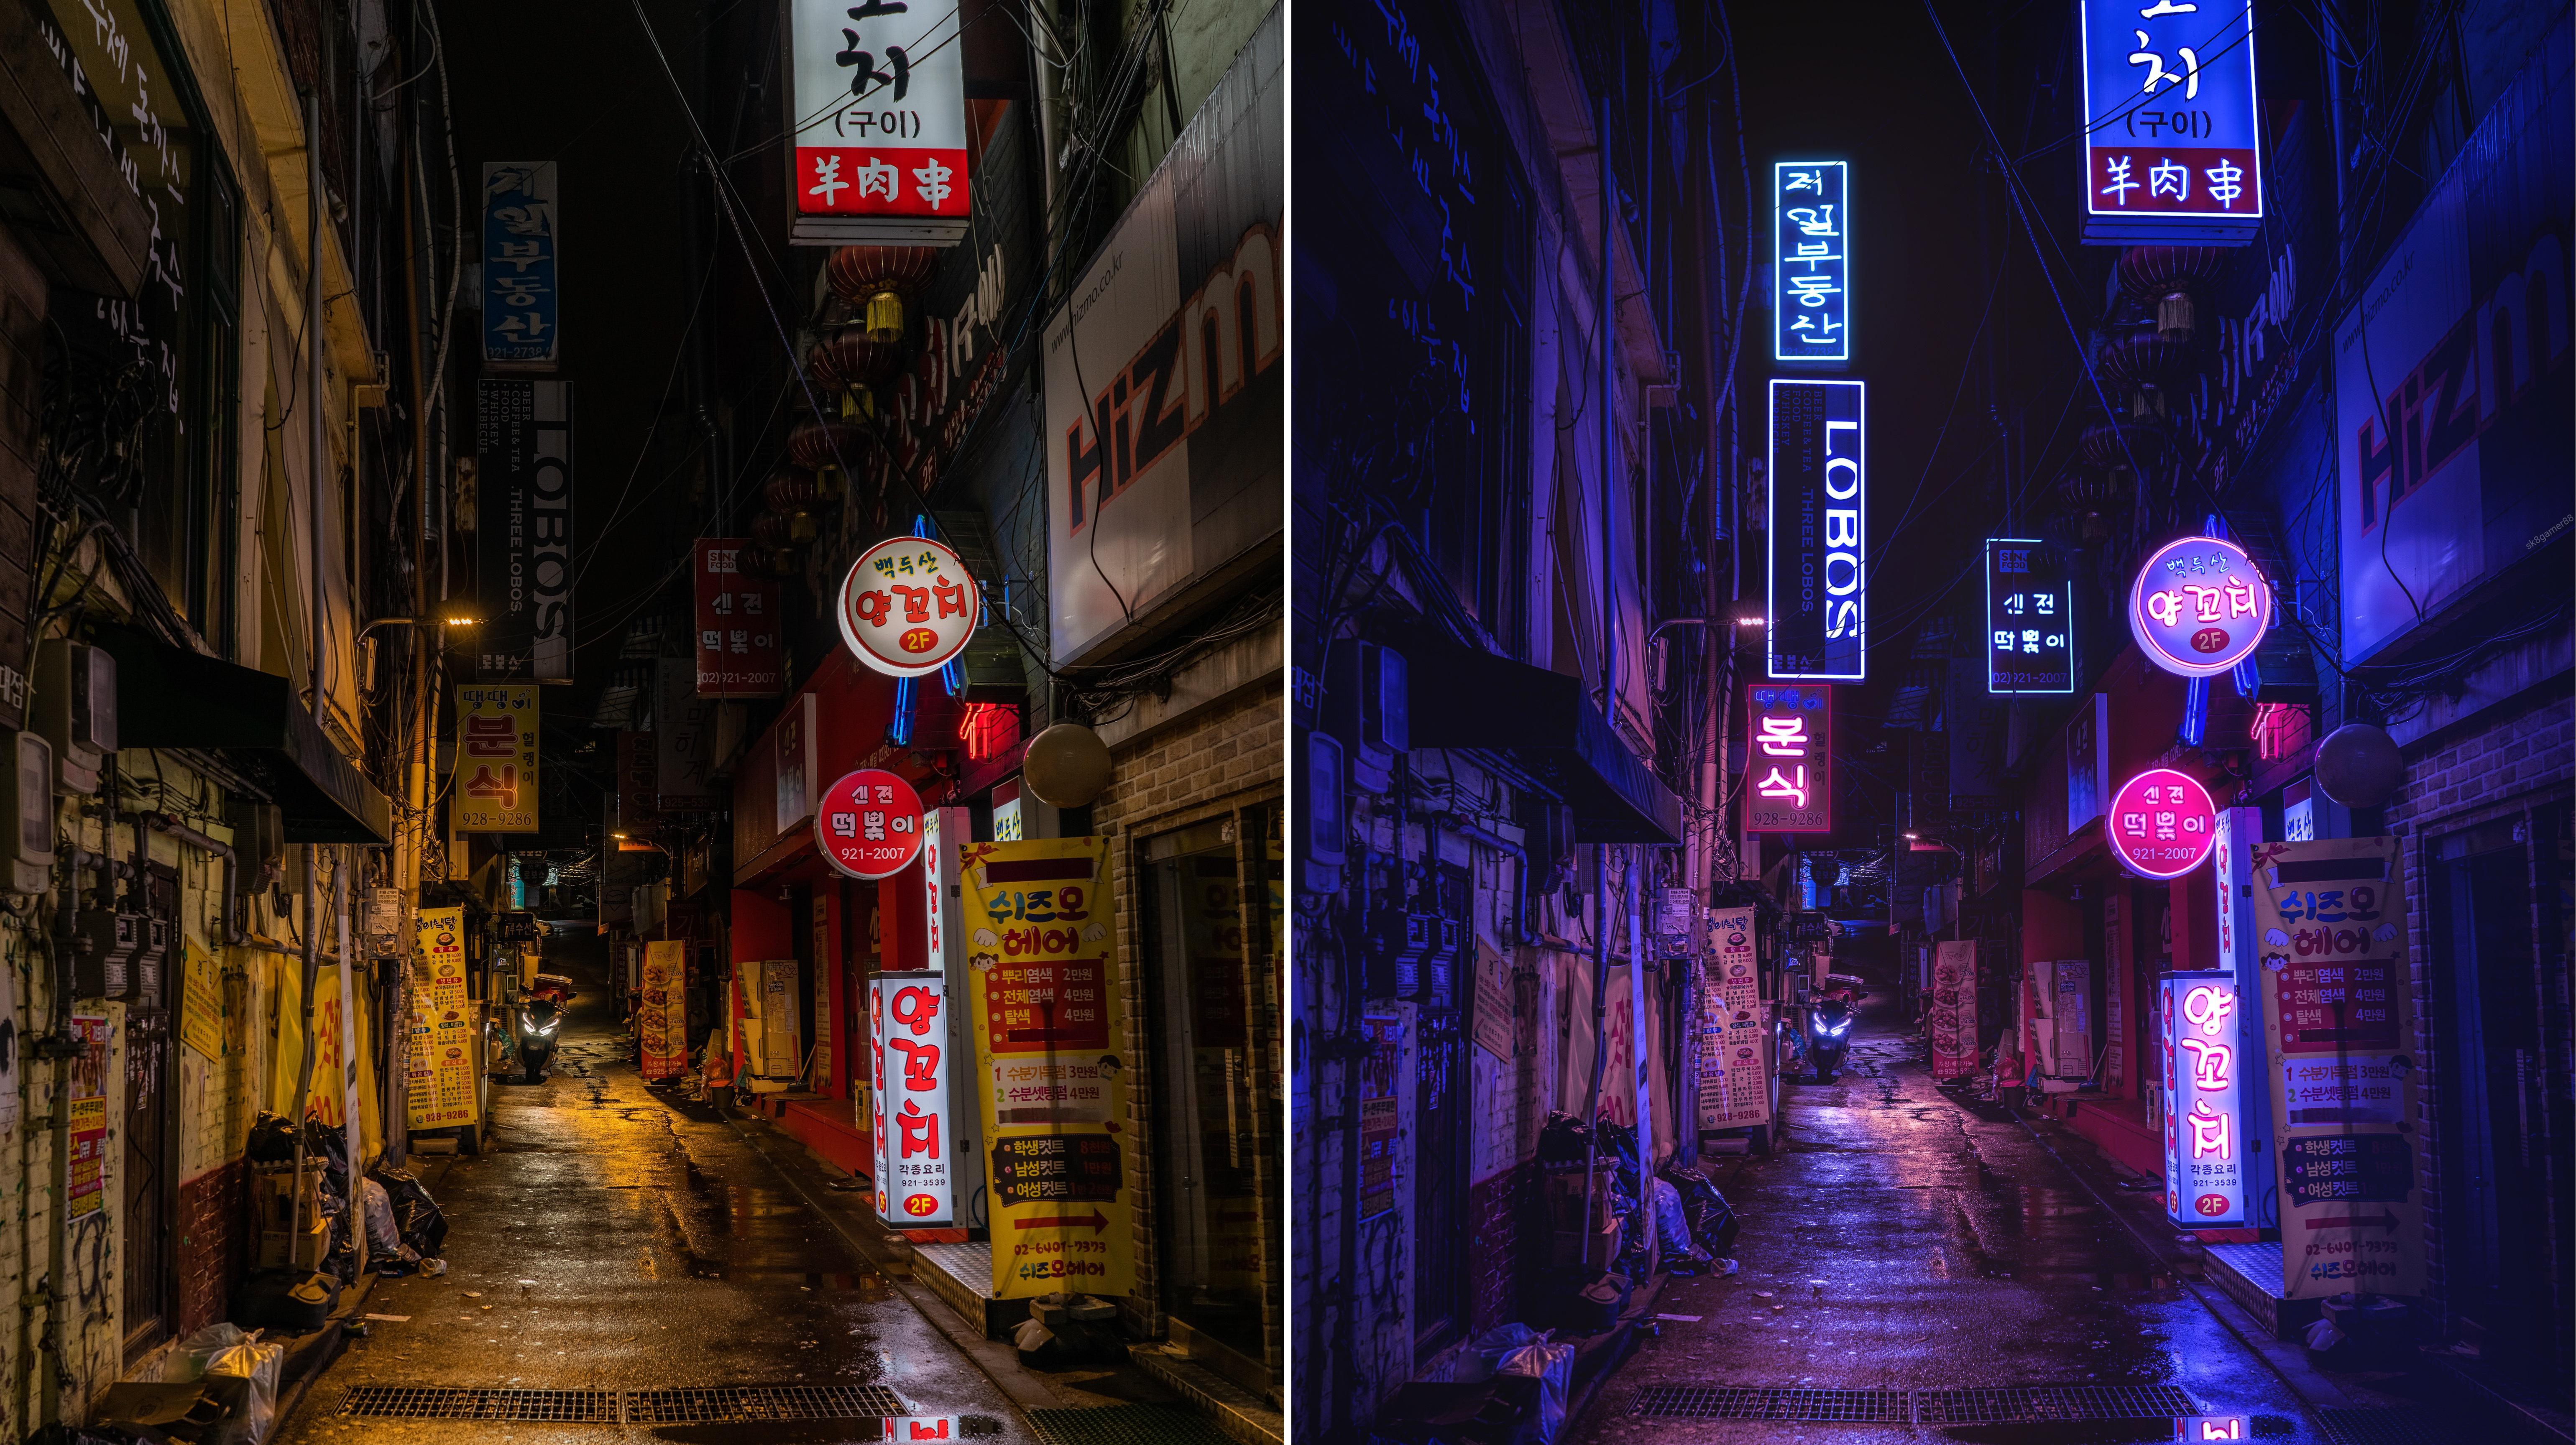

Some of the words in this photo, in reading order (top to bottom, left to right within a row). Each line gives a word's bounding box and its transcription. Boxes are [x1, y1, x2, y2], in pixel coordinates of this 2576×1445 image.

[836, 110, 920, 138] (구이)
[2127, 110, 2212, 138] (구이)
[809, 155, 953, 210] 羊肉串
[2100, 155, 2244, 210] 羊肉串
[1067, 222, 1284, 539] Hizm
[501, 390, 509, 423] FOOD
[511, 390, 520, 434] COFFEE
[522, 390, 531, 421] BEER
[1792, 390, 1801, 423] FOOD
[1802, 390, 1811, 434] COFFEE
[1814, 390, 1822, 421] BEER
[480, 390, 488, 454] BARBECUE
[491, 390, 499, 446] WHISKEY
[1782, 390, 1790, 446] WHISKEY
[511, 448, 520, 473] TEA
[1802, 448, 1811, 473] TEA
[534, 420, 566, 639] LOBOS
[1825, 420, 1858, 639] LOBOS
[874, 551, 938, 579] 백두산
[2166, 551, 2229, 579] 백두산
[712, 592, 763, 615] 신전
[856, 574, 967, 628] 양꼬치
[2004, 593, 2054, 615] 신전
[2147, 574, 2259, 628] 양꼬치
[702, 629, 773, 654] 떡볶이
[907, 631, 930, 650] 2F
[1993, 629, 2064, 654] 떡볶이
[2198, 631, 2221, 650] 2F
[701, 672, 777, 685] 02)921-2007
[1992, 672, 2068, 685] 02)921-2007
[463, 715, 518, 809] 분식
[1755, 715, 1809, 809] 분식
[851, 785, 894, 805] 신전
[2143, 785, 2185, 805] 신전
[462, 812, 532, 826] 928-9286
[831, 810, 914, 841] 떡볶이
[1753, 812, 1823, 826] 928-9286
[2123, 810, 2205, 841] 떡볶이
[841, 847, 905, 860] 921-2007
[2132, 847, 2197, 860] 921-2007
[928, 843, 939, 954] 양꼬치
[988, 886, 1089, 924] 쉬즈모
[2280, 886, 2380, 924] 쉬즈모
[1002, 926, 1079, 956] 헤어
[2293, 926, 2371, 956] 헤어
[1002, 967, 1053, 985] 뿌리염색
[1063, 967, 1093, 982] 2만원
[2293, 967, 2344, 985] 뿌리염색
[2354, 967, 2384, 982] 2만원
[1003, 988, 1054, 1005] 전체염색
[1063, 988, 1094, 1002] 4만원
[2295, 988, 2346, 1005] 전체염색
[2355, 988, 2385, 1002] 4만원
[1004, 1009, 1030, 1025] 탈색
[1064, 1008, 1095, 1022] 4만원
[2296, 1009, 2322, 1025] 탈색
[2356, 1008, 2386, 1022] 4만원
[871, 985, 886, 1159] 양꼬치
[889, 985, 941, 1160] 양꼬치
[1007, 1065, 1066, 1081] 수분가득펌
[1069, 1065, 1098, 1079] 3만원
[2180, 985, 2232, 1160] 양꼬치
[2298, 1065, 2358, 1081] 수분가득펌
[2360, 1065, 2389, 1079] 3만원
[1008, 1085, 1067, 1102] 수분셋팅펌
[1069, 1086, 1099, 1100] 4만원
[2300, 1085, 2359, 1102] 수분셋팅펌
[2361, 1086, 2390, 1100] 4만원
[426, 1109, 469, 1122] 928-9286
[1717, 1109, 1760, 1122] 928-9286
[1014, 1139, 1066, 1156] 학생컷트
[2305, 1139, 2357, 1156] 학생컷트
[899, 1164, 945, 1175] 각종요리
[1015, 1160, 1067, 1177] 남성컷트
[2190, 1164, 2236, 1175] 각종요리
[2306, 1160, 2358, 1177] 남성컷트
[1017, 1180, 1068, 1198] 여성컷트
[2308, 1180, 2359, 1198] 여성컷트
[879, 1194, 885, 1210] 2F
[910, 1197, 931, 1213] 2F
[2202, 1197, 2223, 1213] 2F
[1014, 1241, 1107, 1256] 02-6401-7373
[2305, 1241, 2398, 1256] 02-6401-7373
[1019, 1259, 1105, 1280] 쉬즈모헤어
